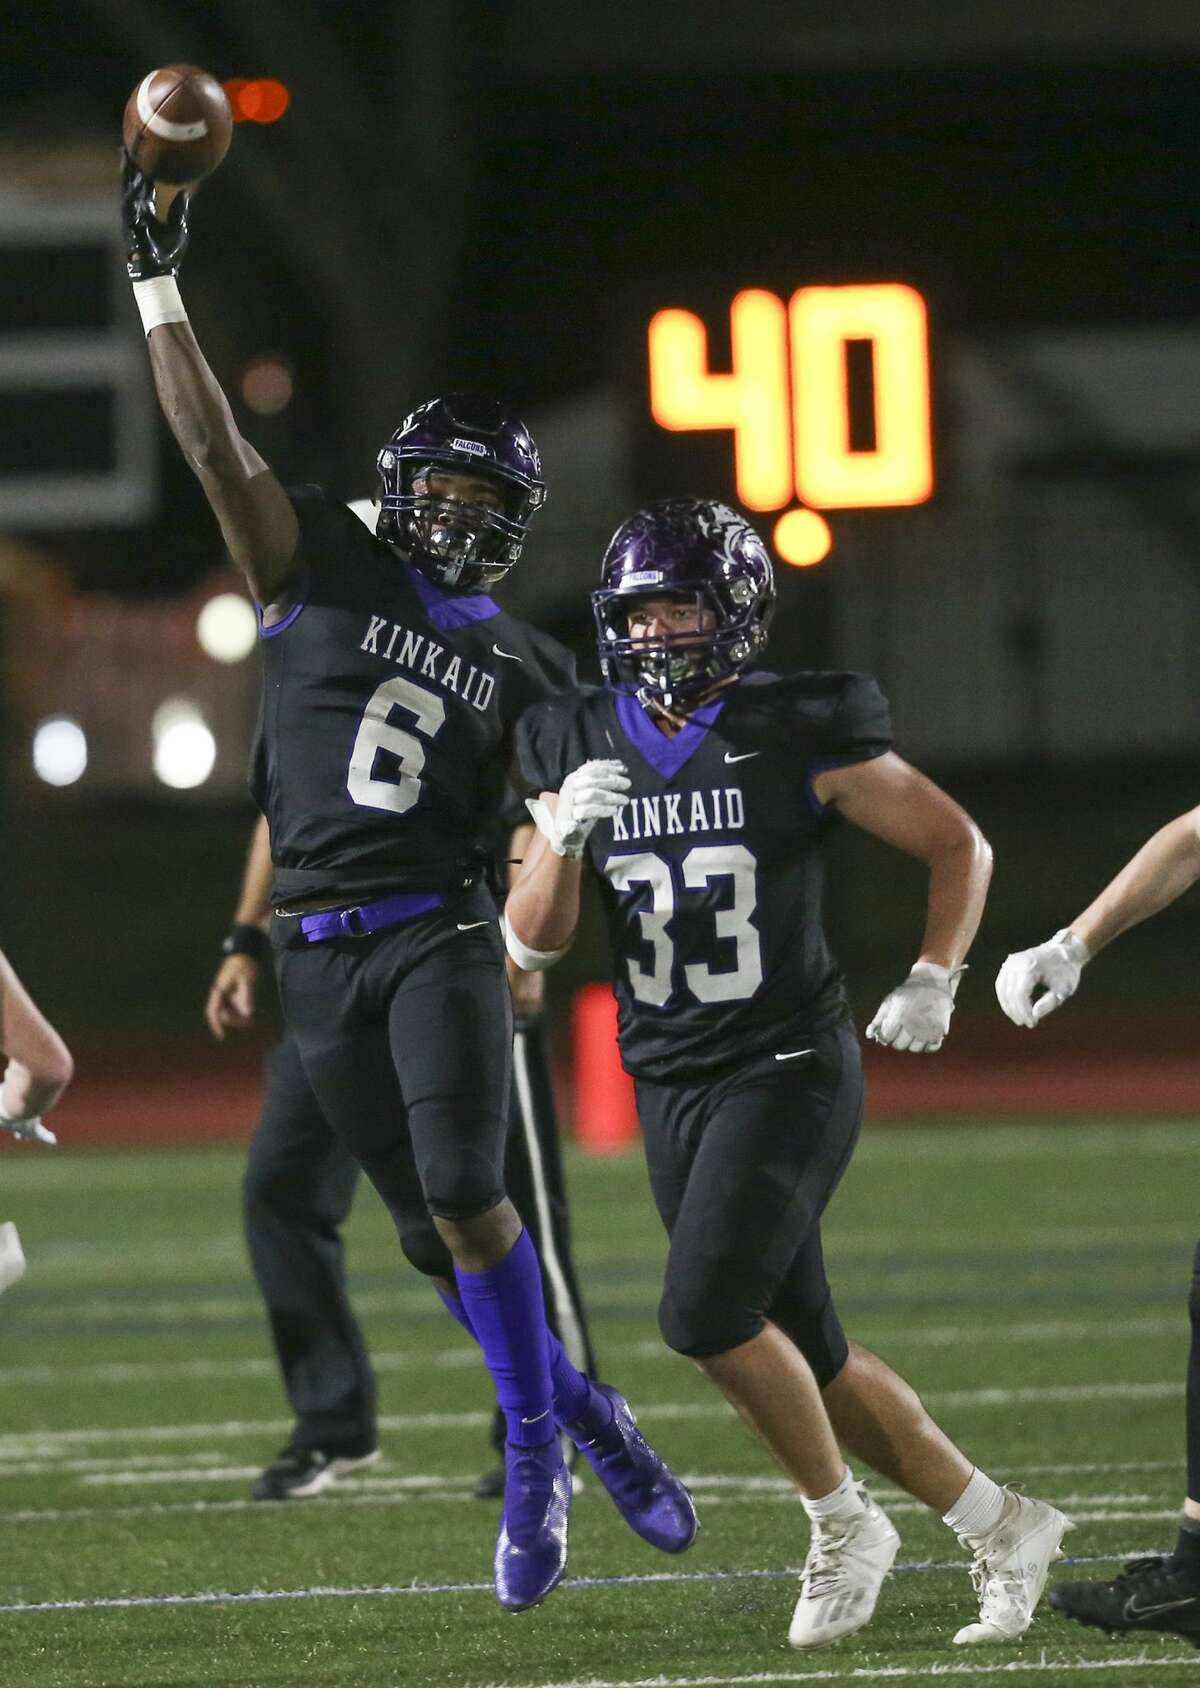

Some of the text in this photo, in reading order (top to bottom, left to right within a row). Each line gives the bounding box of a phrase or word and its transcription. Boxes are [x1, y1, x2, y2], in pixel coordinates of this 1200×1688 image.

[454, 440, 484, 454] FALCONS
[649, 283, 934, 512] 40
[360, 614, 495, 712] KINKAID
[346, 675, 447, 814] 6
[612, 787, 745, 841] KINKAID
[603, 844, 763, 1007] 33
